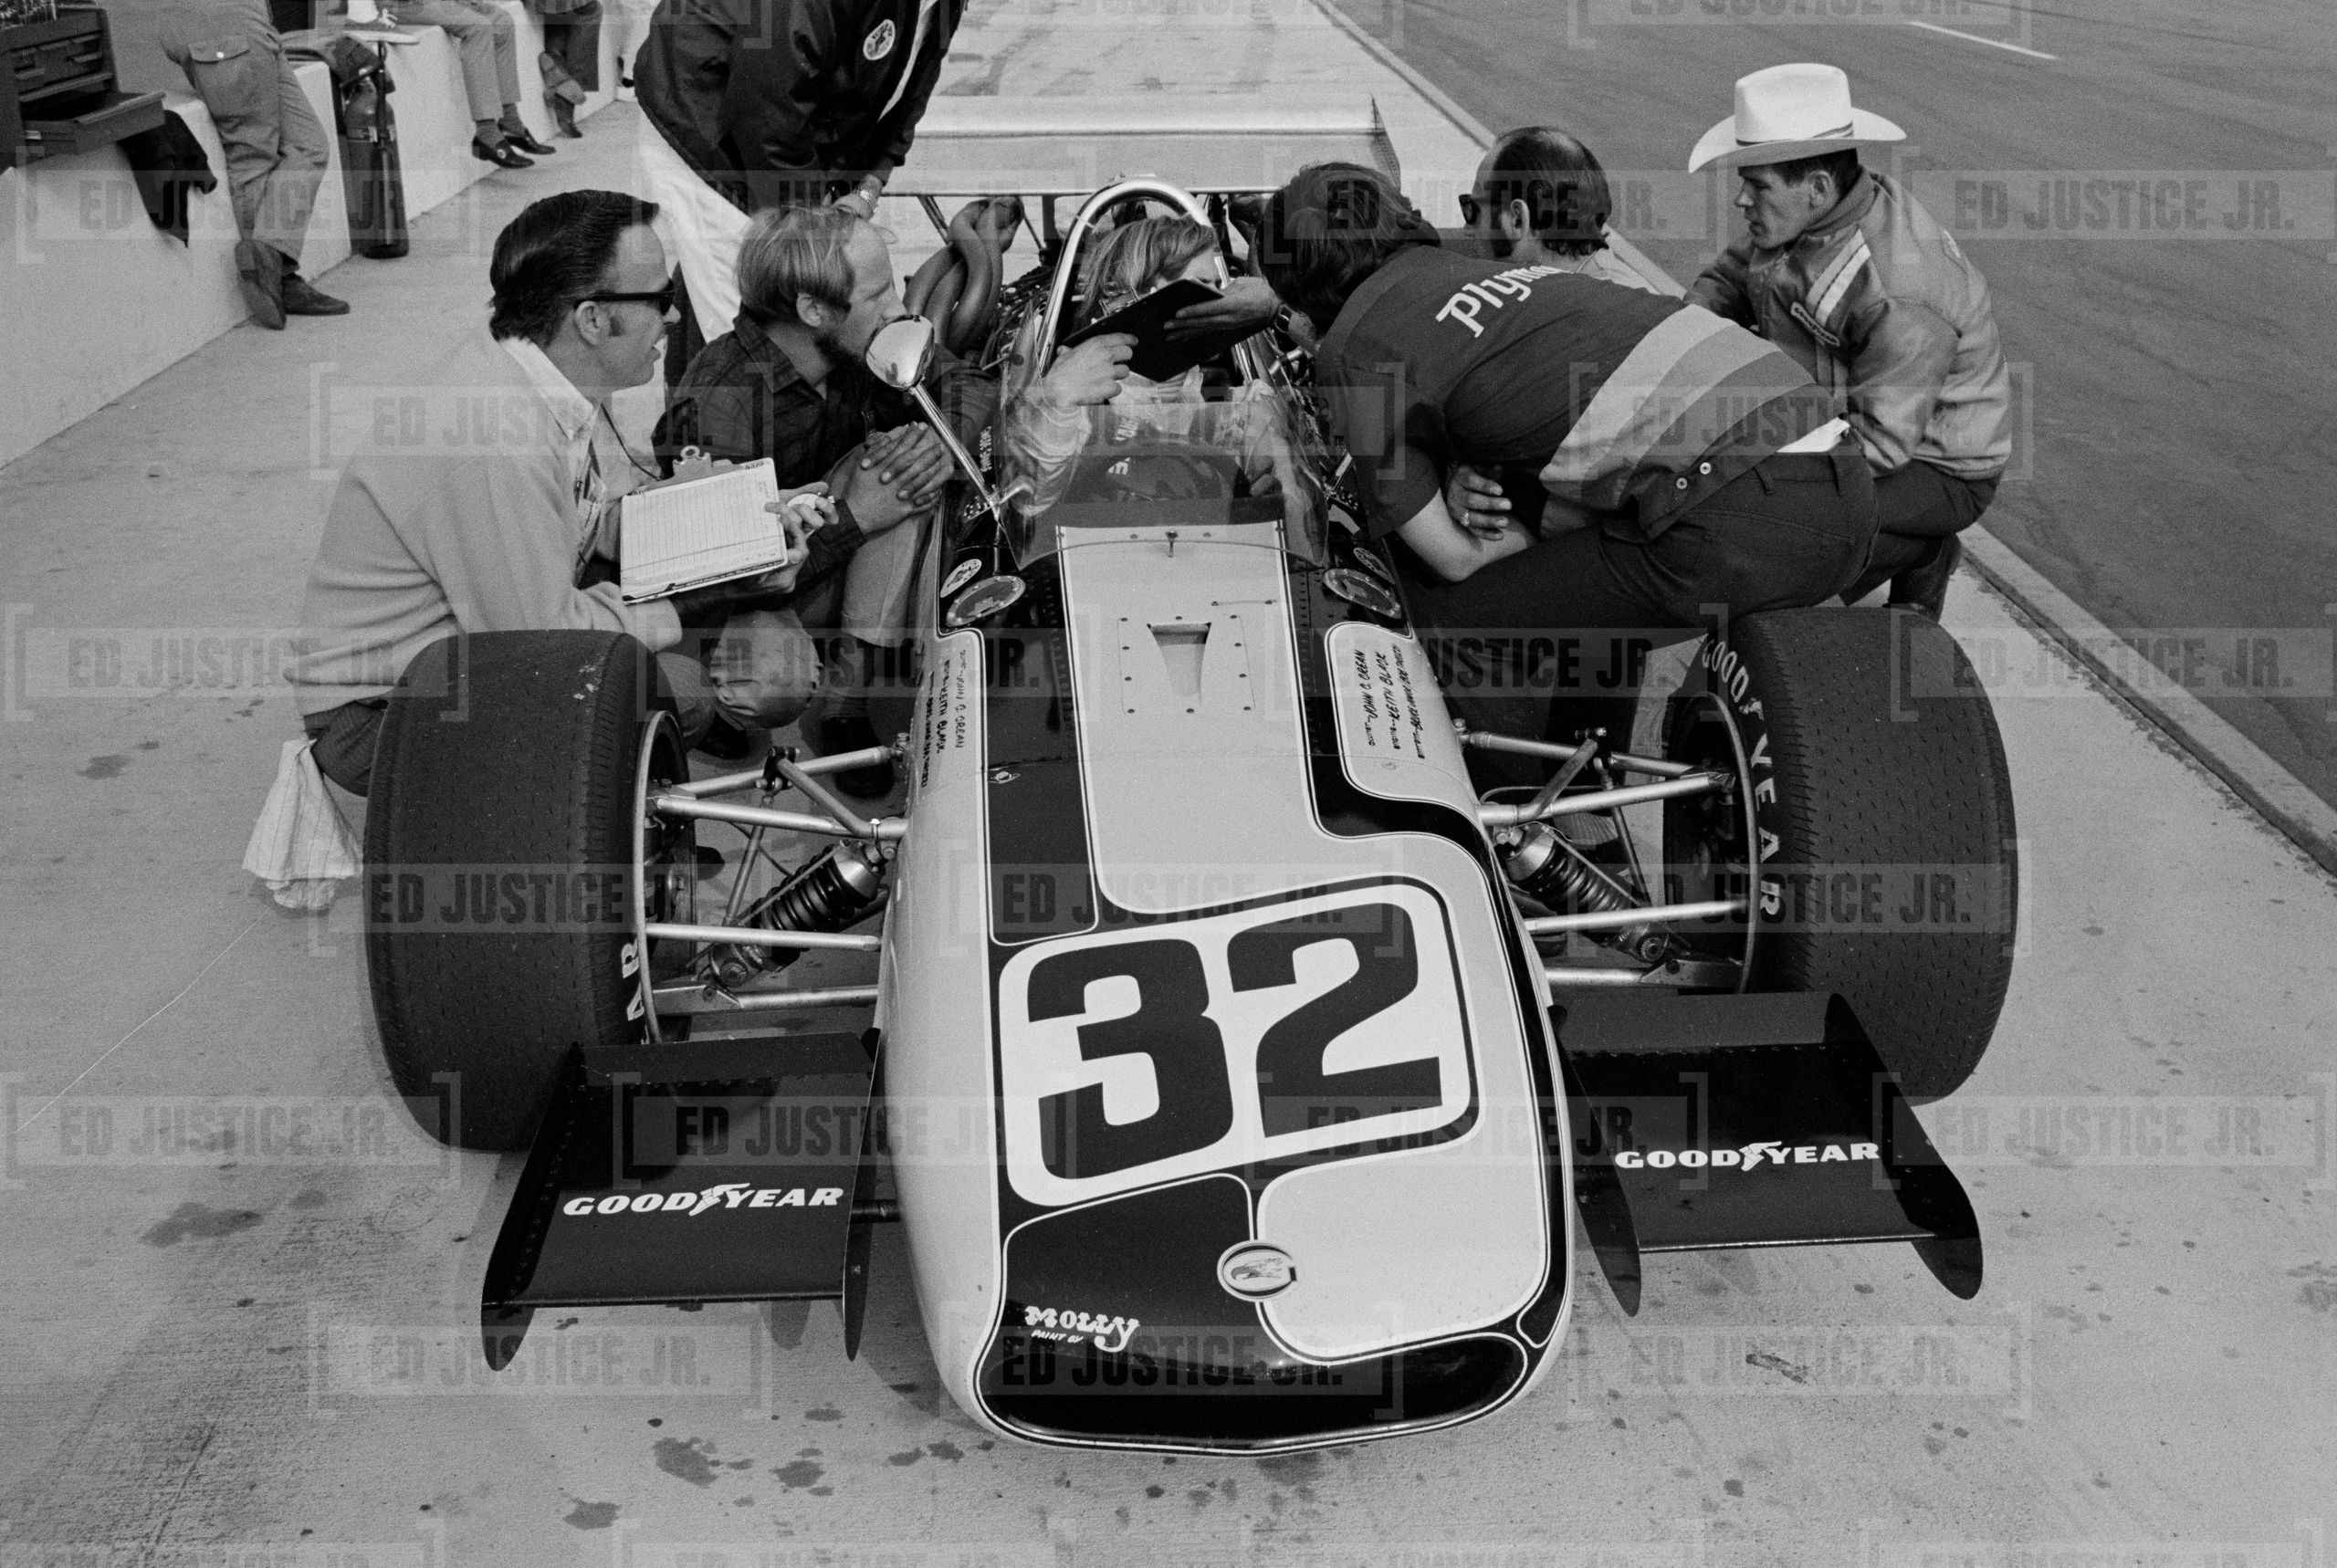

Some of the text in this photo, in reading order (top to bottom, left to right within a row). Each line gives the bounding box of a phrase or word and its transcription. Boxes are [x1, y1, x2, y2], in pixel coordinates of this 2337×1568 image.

[1435, 265, 1574, 339] Plymo
[1354, 649, 1371, 681] CREAN
[1375, 651, 1394, 686] BLACK
[1702, 637, 1780, 915] GOODYEAR
[1027, 903, 1442, 1179] 32
[1615, 1141, 1880, 1171] GOODYEAR
[563, 1184, 844, 1216] GOODYEAR
[1024, 1305, 1141, 1353] MOLLY
[1031, 1329, 1067, 1342] PAINT
